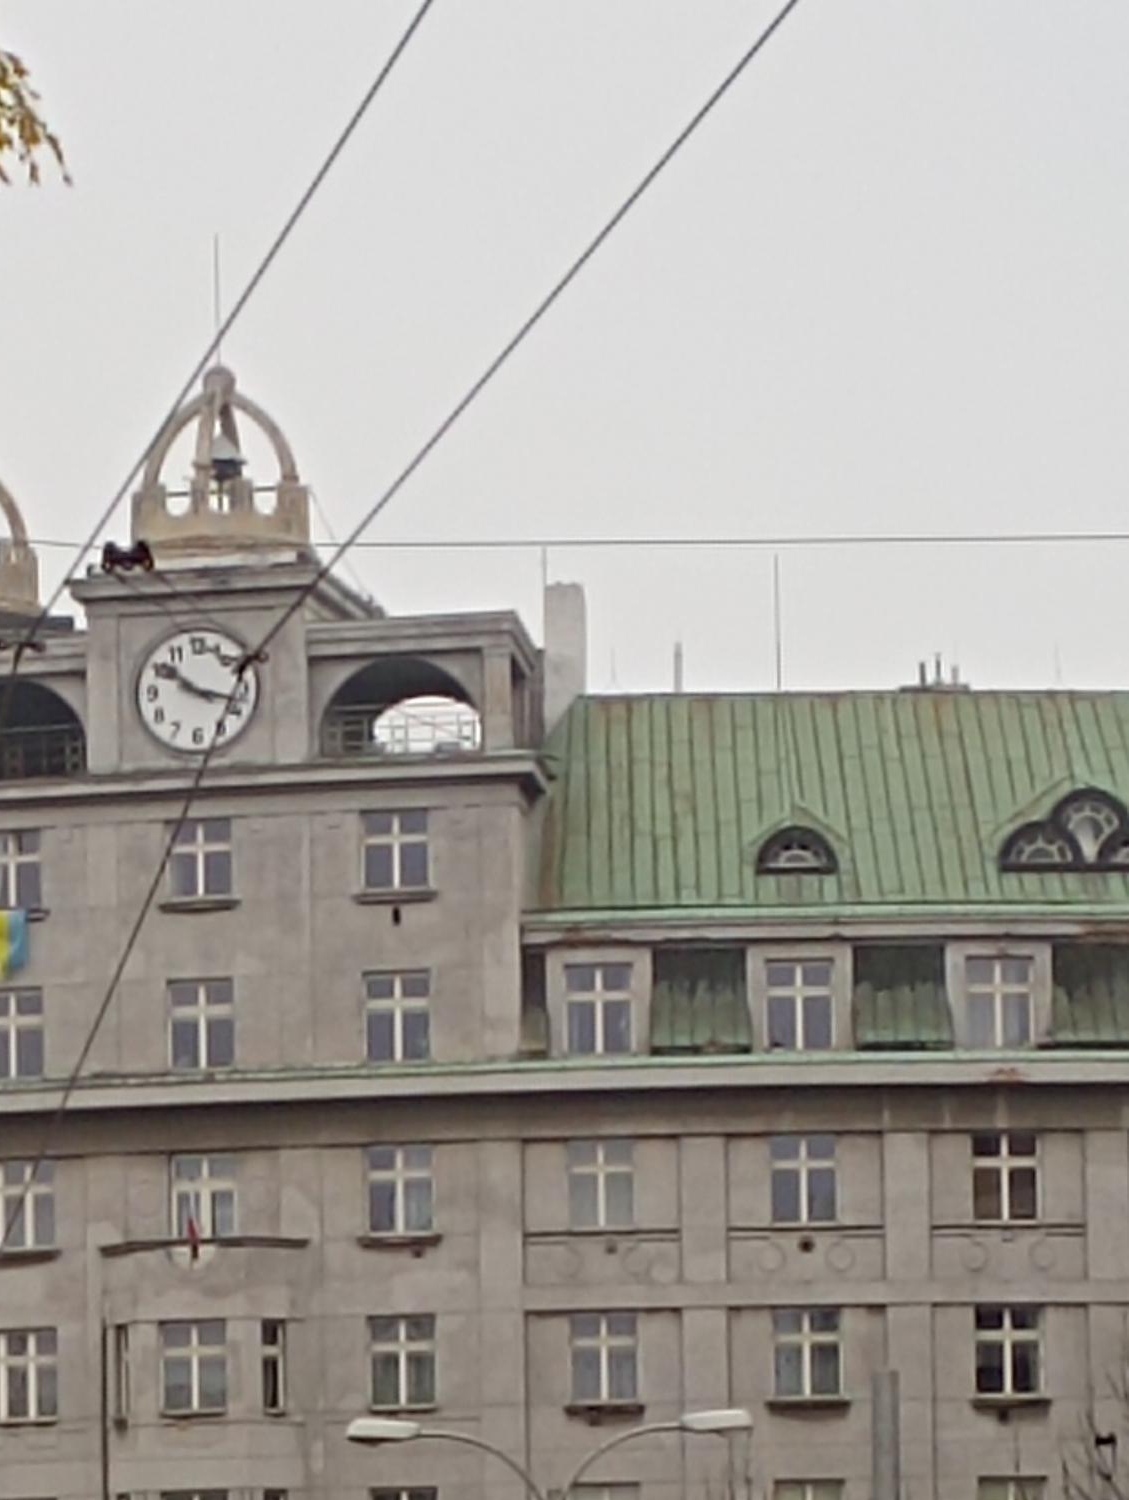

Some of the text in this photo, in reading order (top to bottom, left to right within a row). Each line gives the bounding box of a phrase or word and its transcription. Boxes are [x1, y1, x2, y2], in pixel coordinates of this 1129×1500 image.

[169, 645, 184, 662] 11
[189, 636, 206, 655] 12
[146, 684, 159, 702] 9
[154, 707, 165, 724] 8
[170, 720, 182, 739] 7
[191, 728, 204, 745] 6
